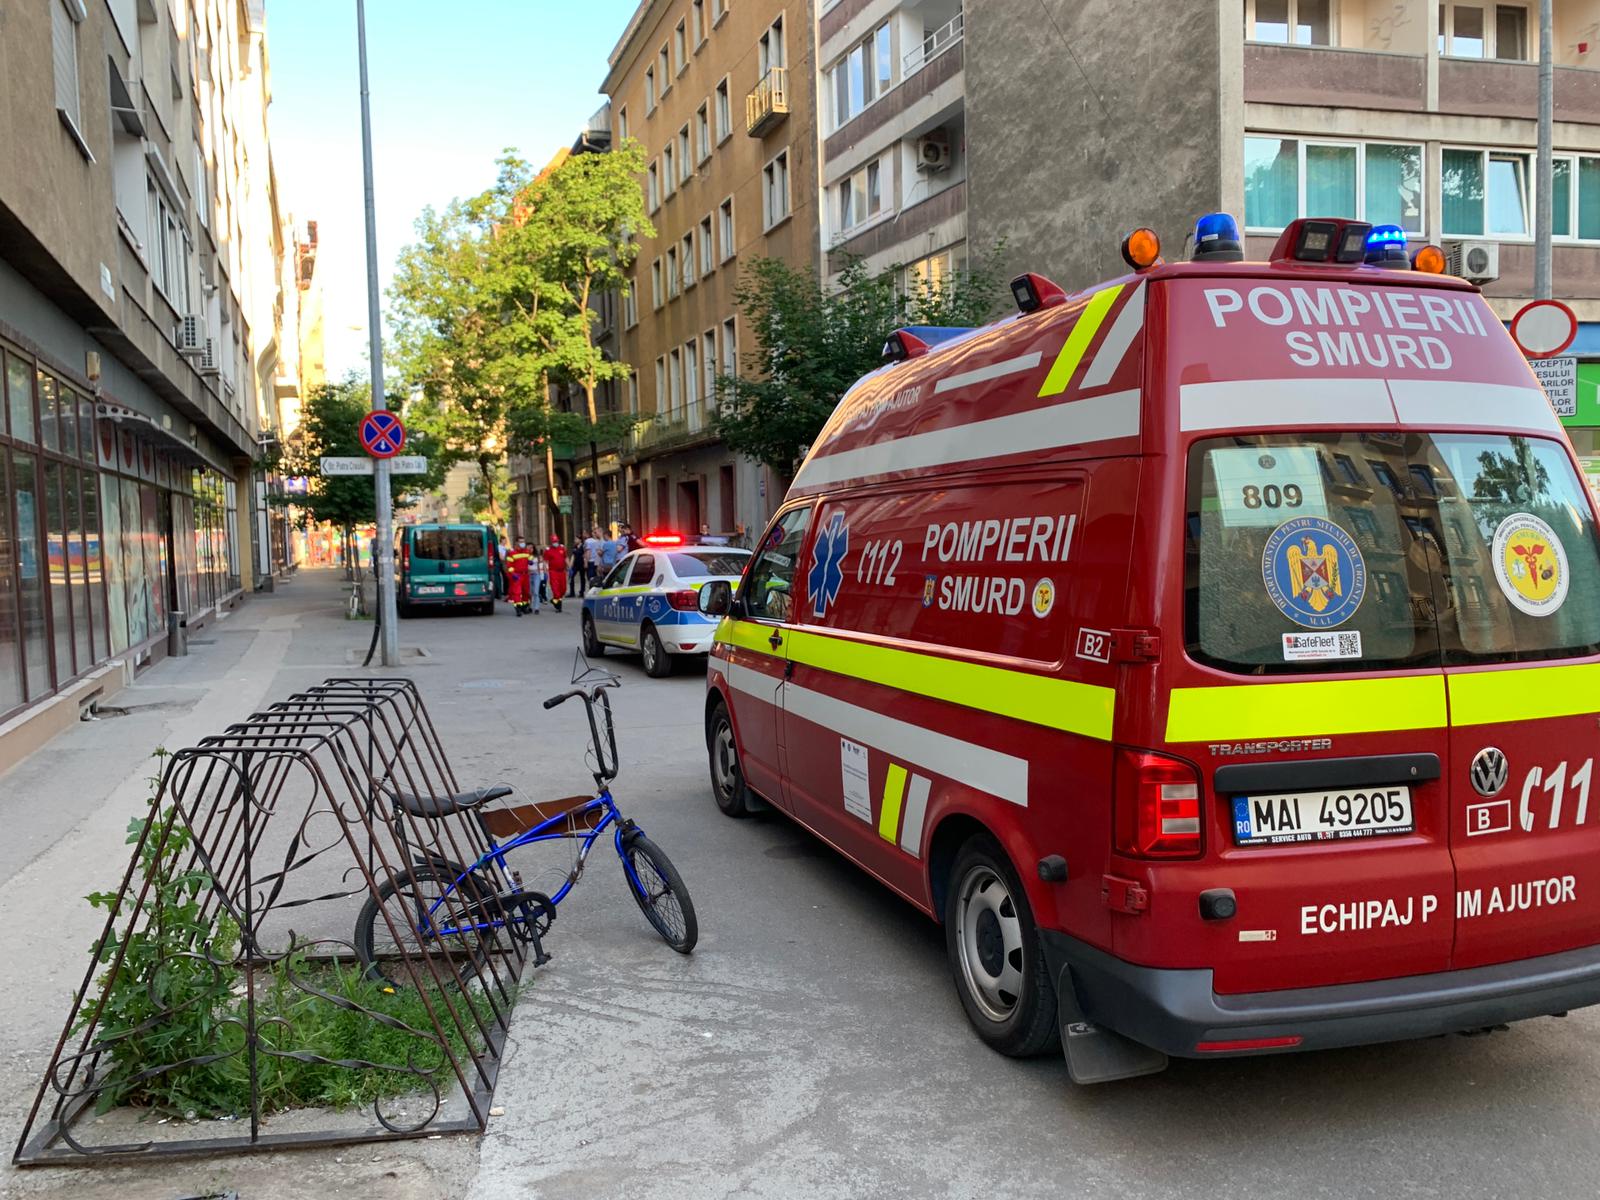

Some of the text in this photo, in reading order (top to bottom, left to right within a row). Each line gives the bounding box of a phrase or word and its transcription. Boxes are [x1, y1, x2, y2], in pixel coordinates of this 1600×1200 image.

[1203, 286, 1487, 337] POMPIERII
[1285, 330, 1454, 371] SMURD
[1536, 370, 1570, 379] ESULUI
[1540, 379, 1574, 387] ARILOR
[887, 386, 922, 411] AJUTOR
[1550, 398, 1571, 407] LOR
[1555, 407, 1575, 415] AJE
[1242, 483, 1304, 510] 809
[921, 514, 1076, 562] POMPIERII
[866, 540, 903, 586] 112
[1264, 534, 1287, 609] DEPARTAMENTUL
[1282, 518, 1312, 535] PENTRU
[938, 575, 1025, 616] SMURD
[1084, 634, 1104, 657] B2
[1296, 636, 1336, 648] SafeFleet
[1208, 738, 1332, 756] TRANSPORTER
[1253, 790, 1405, 833] MAI 49205
[1478, 808, 1491, 830] B
[1236, 821, 1251, 834] RO
[1271, 834, 1296, 844] SERVICE
[1297, 833, 1312, 842] AUTO
[1301, 897, 1413, 935] ECHIPAJ
[1488, 875, 1577, 915] AJUTOR
